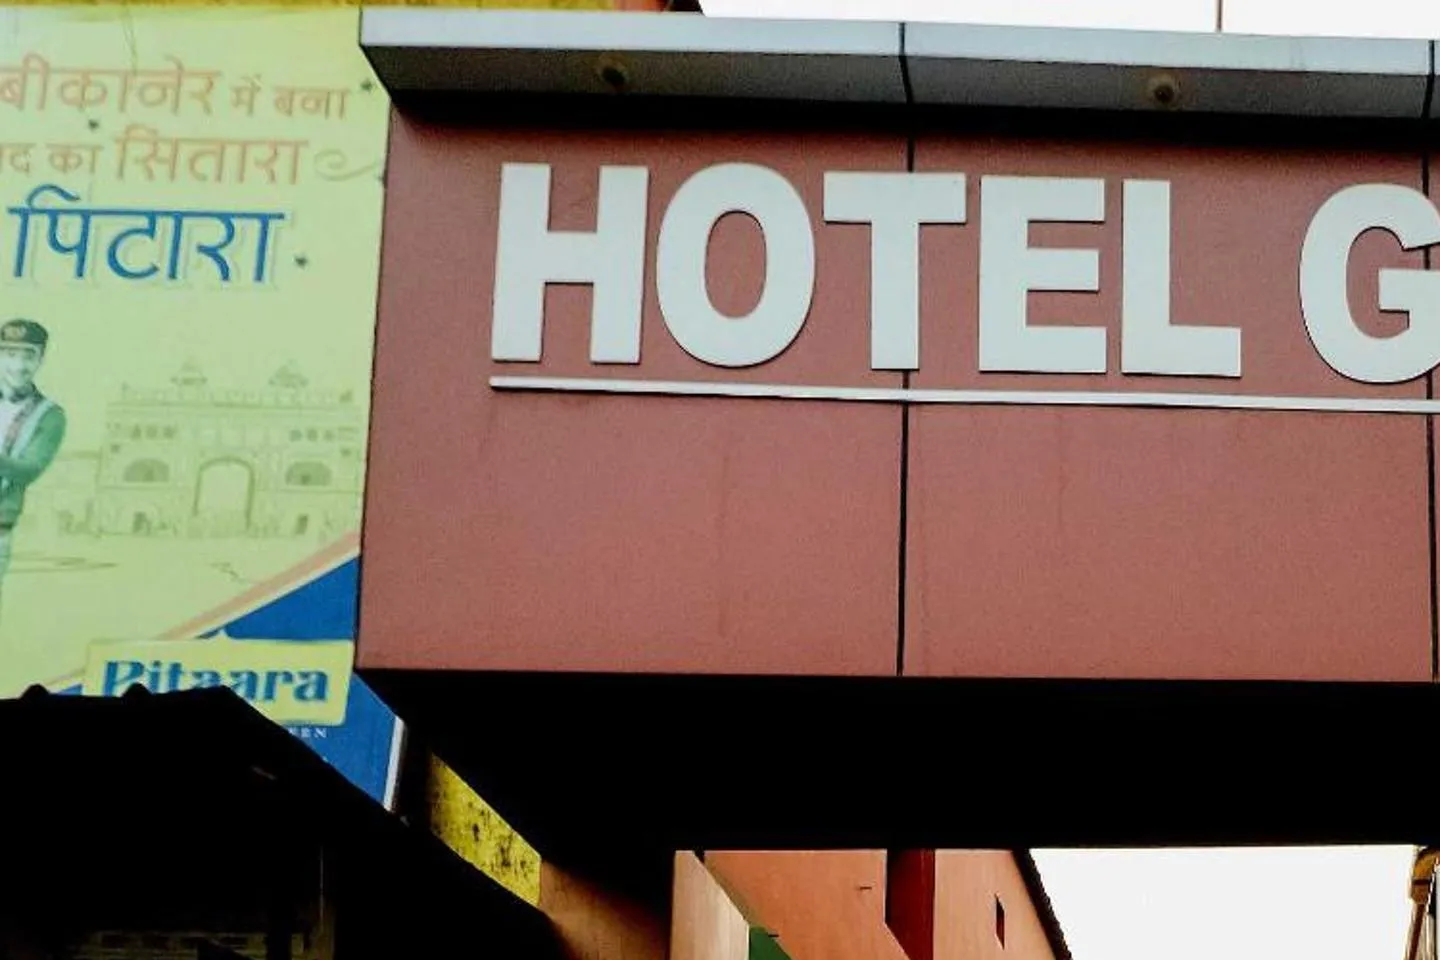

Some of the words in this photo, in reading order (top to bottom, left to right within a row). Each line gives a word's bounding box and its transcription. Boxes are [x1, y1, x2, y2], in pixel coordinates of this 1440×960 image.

[229, 75, 266, 118] में
[273, 86, 351, 119] बना
[44, 142, 104, 176] का
[113, 124, 309, 185] सितारा
[7, 184, 285, 282] पिटारा
[491, 161, 1241, 377] HOTEL
